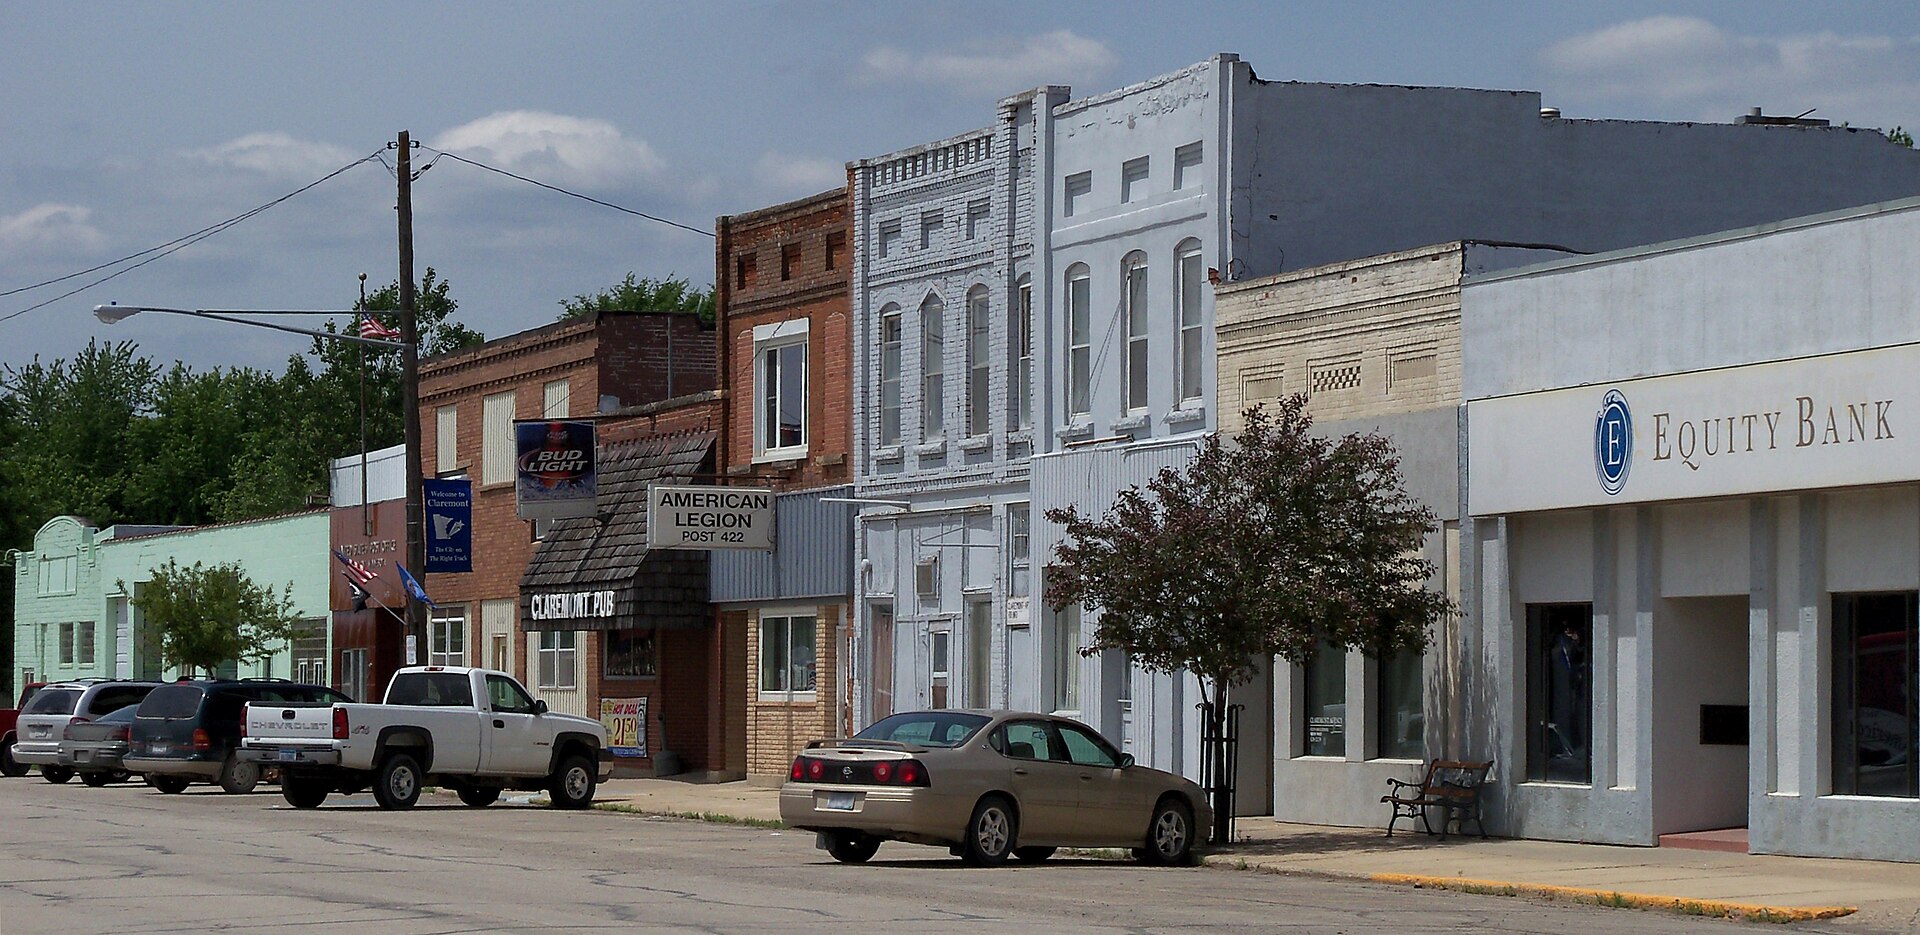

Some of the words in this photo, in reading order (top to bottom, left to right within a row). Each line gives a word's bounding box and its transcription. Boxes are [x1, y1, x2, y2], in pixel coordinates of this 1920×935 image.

[1653, 411, 1782, 471] EQUITY
[1795, 396, 1896, 448] BANK
[1606, 419, 1621, 467] E
[537, 450, 583, 461] BUD
[527, 461, 588, 472] LIGHT
[430, 490, 457, 498] Welcome
[458, 490, 465, 498] to
[427, 499, 469, 507] Claremont
[660, 492, 768, 509] AMERICAN
[675, 512, 752, 528] LEGION
[682, 530, 716, 542] POST
[720, 532, 744, 543] 422
[440, 555, 453, 563] Right
[531, 593, 590, 620] CLAREMONT
[593, 590, 615, 618] PUB
[251, 721, 328, 730] CHEVROLET
